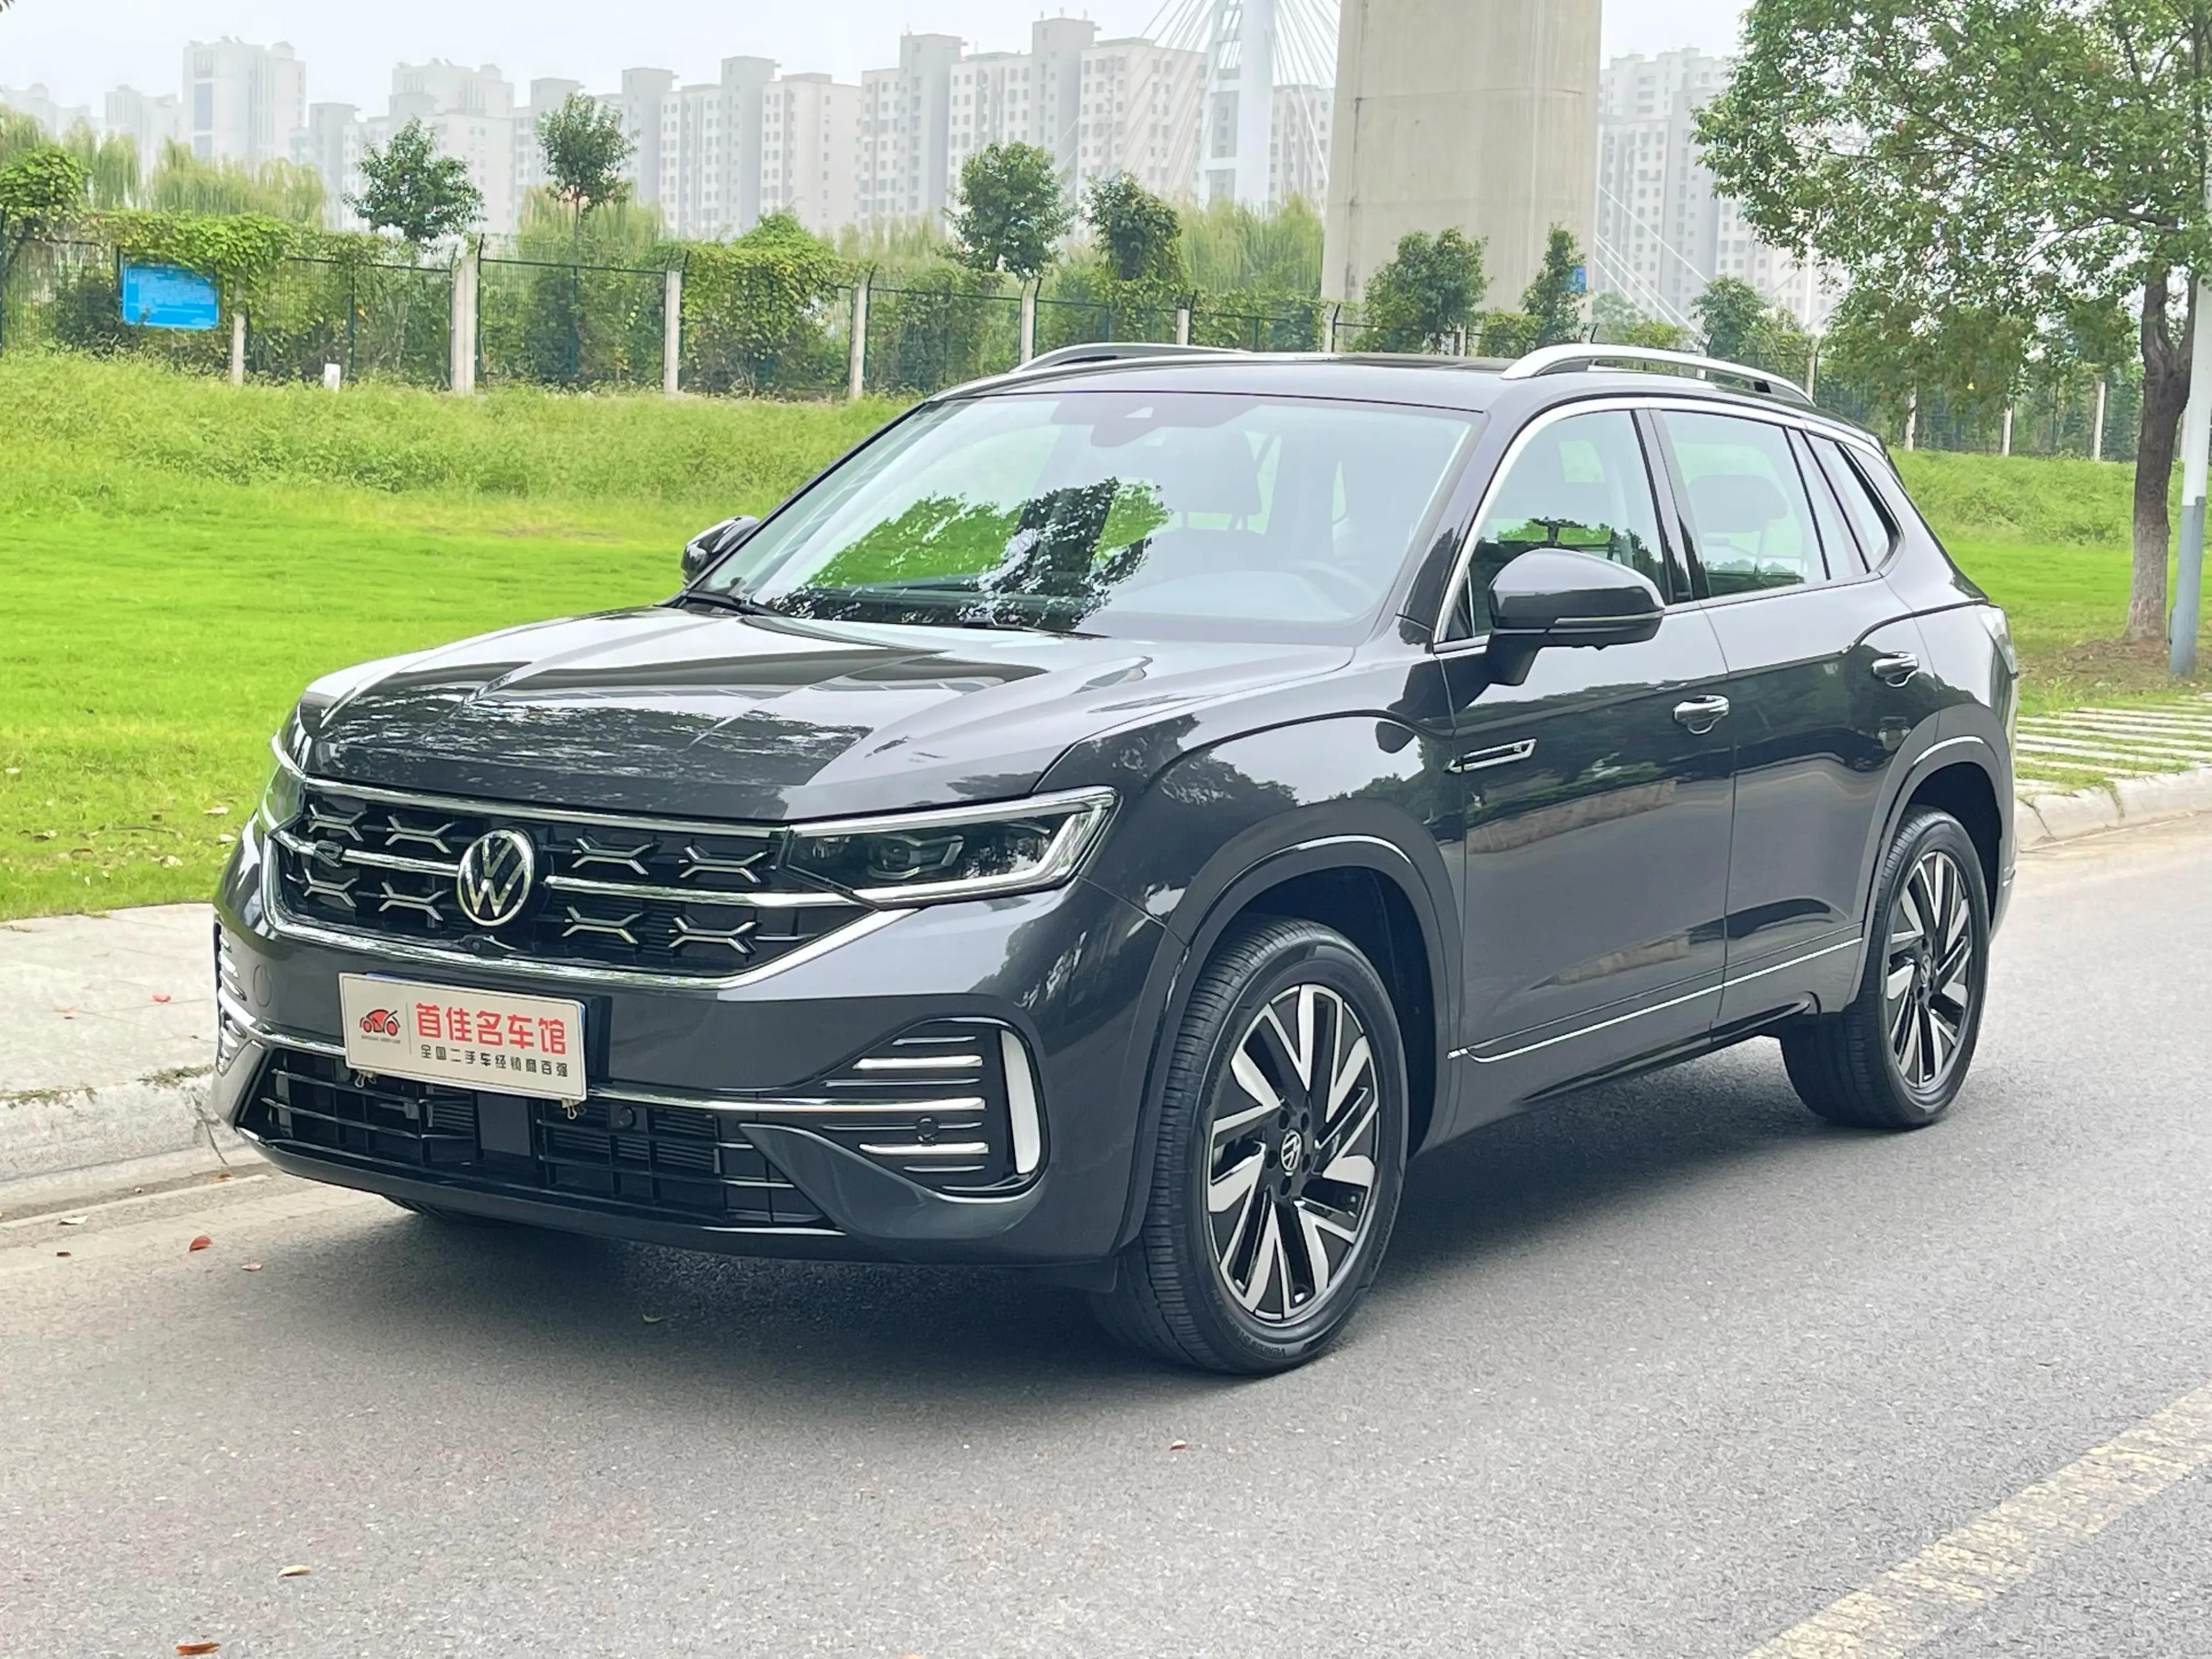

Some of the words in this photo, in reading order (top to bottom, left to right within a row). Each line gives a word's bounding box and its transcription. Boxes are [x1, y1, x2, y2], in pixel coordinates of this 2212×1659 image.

[458, 830, 533, 925] VW
[415, 1003, 566, 1055] 首佳名车馆
